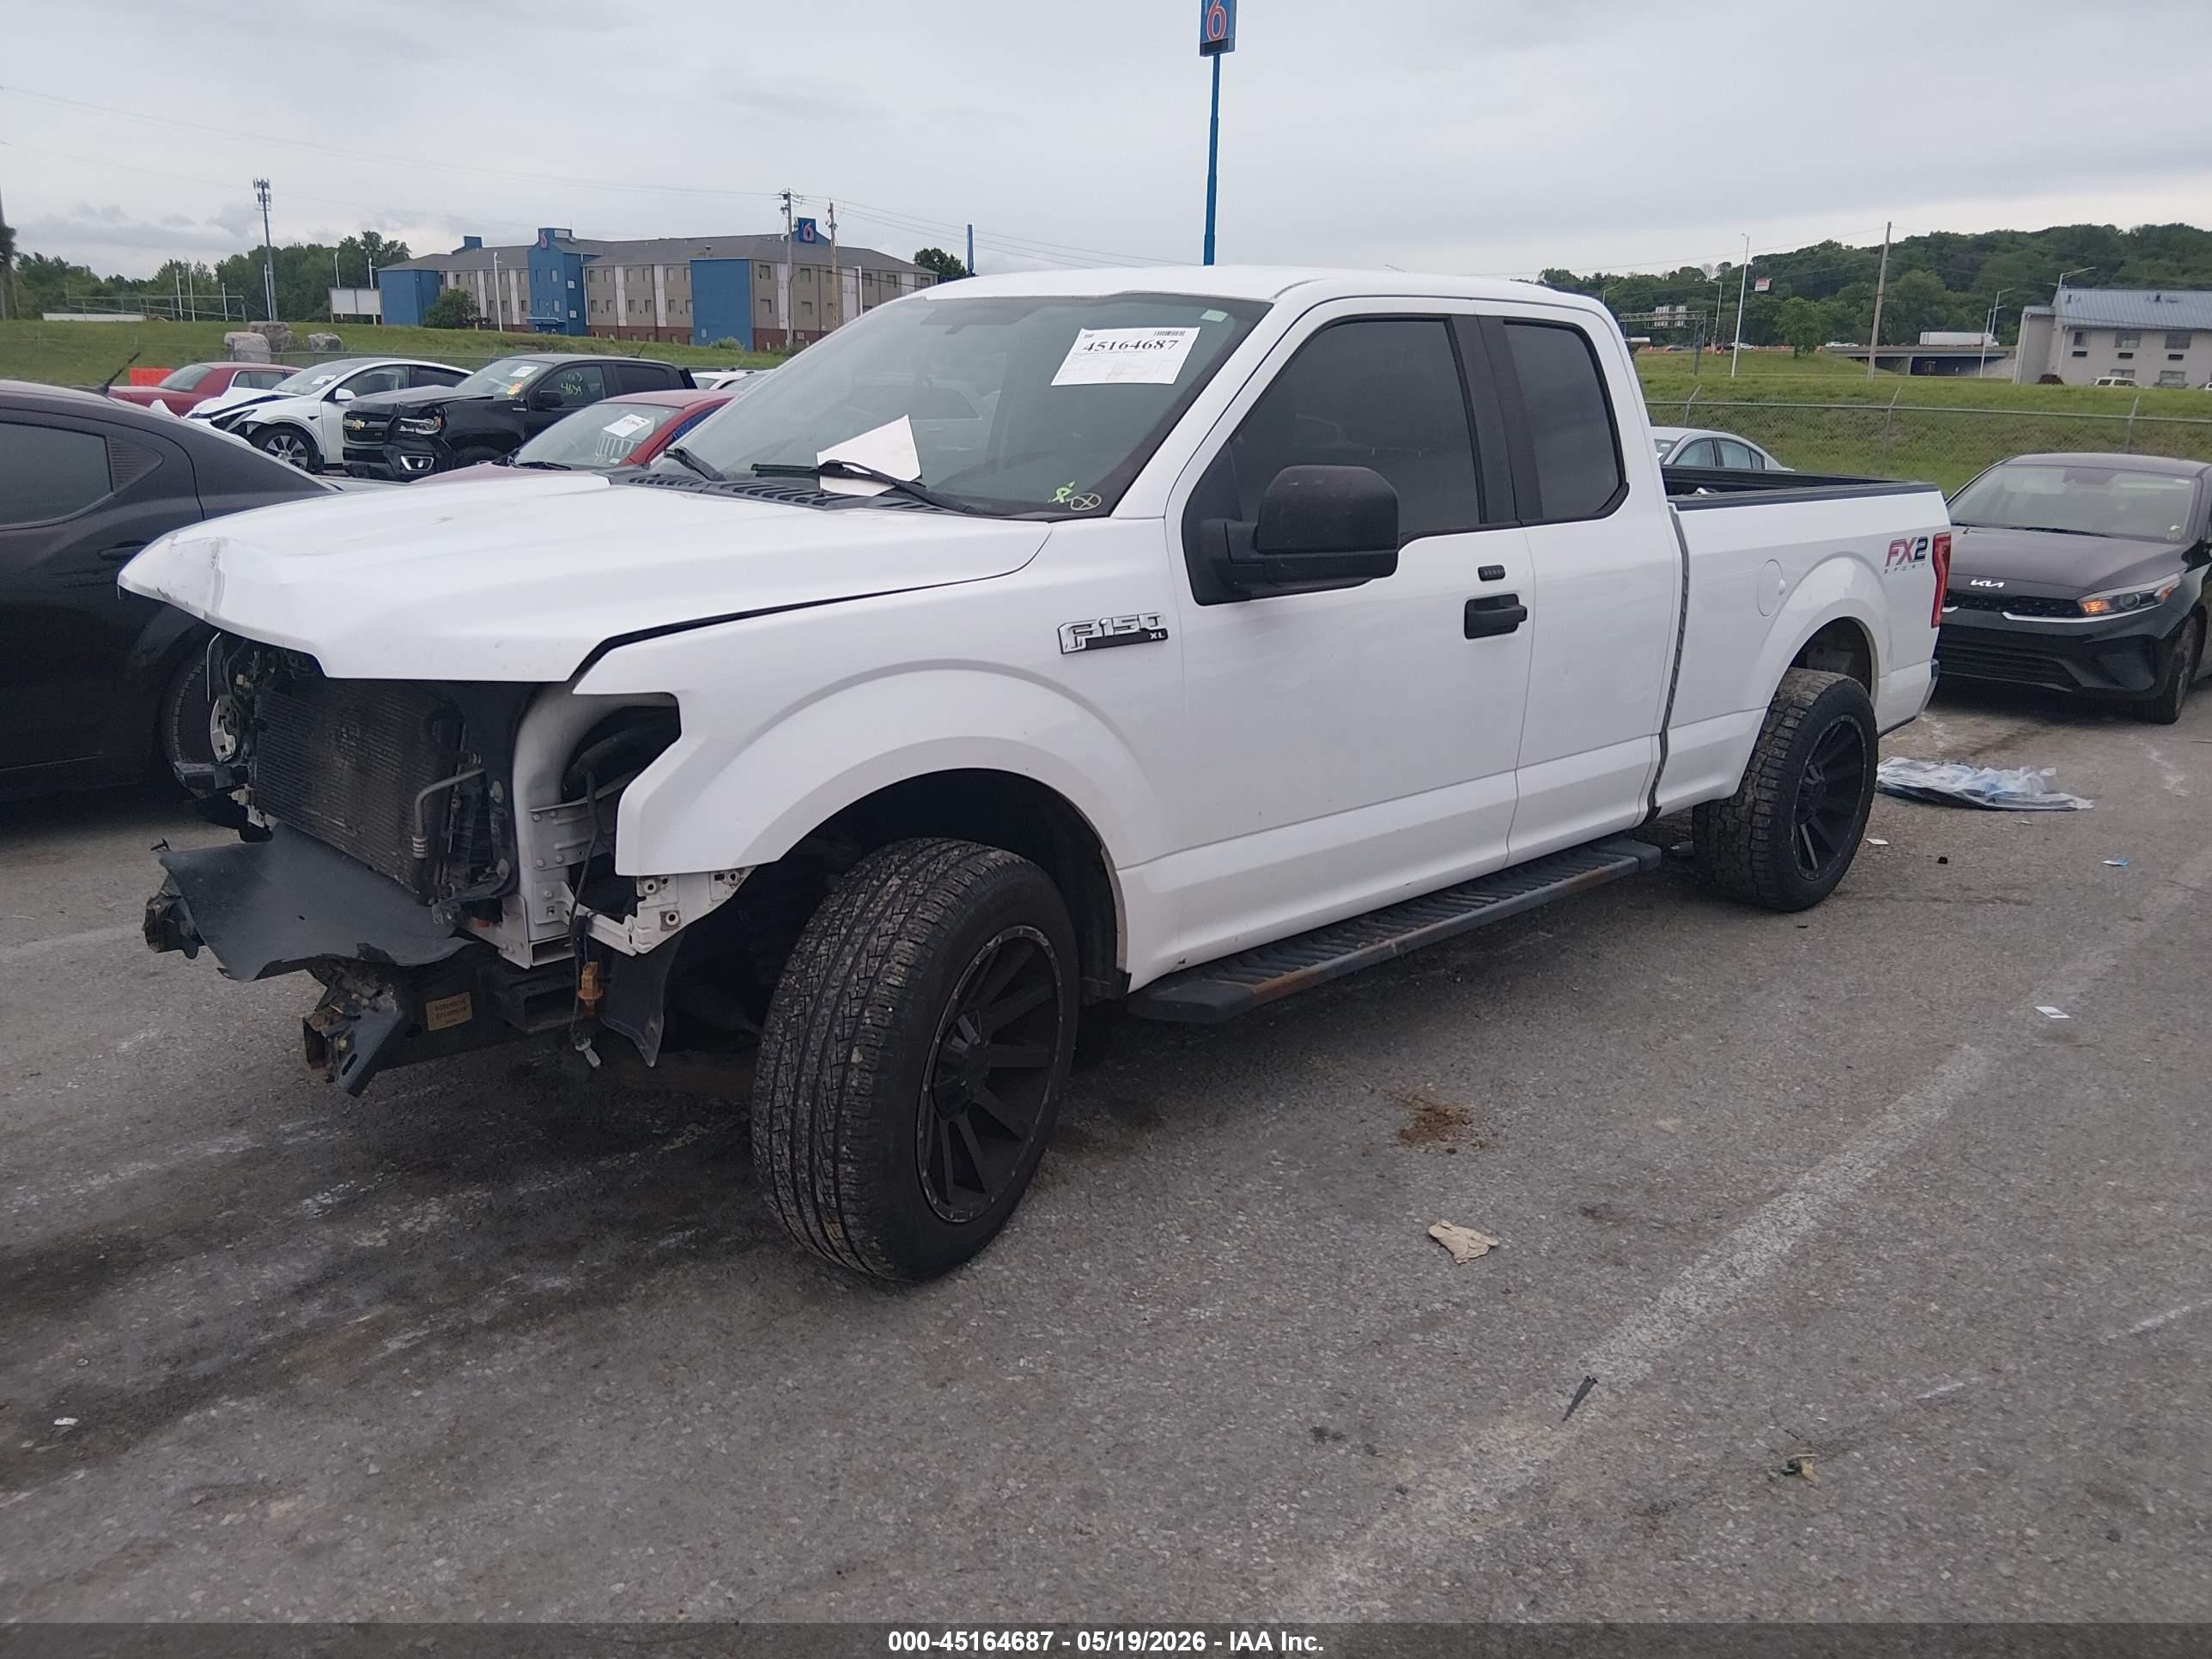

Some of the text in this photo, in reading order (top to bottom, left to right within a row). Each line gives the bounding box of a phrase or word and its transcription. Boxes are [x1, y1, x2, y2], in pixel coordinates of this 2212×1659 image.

[1206, 0, 1227, 41] 6
[804, 222, 815, 242] 6
[1084, 339, 1179, 352] 45164687
[1885, 536, 1929, 567] FX2
[1149, 631, 1166, 640] XL
